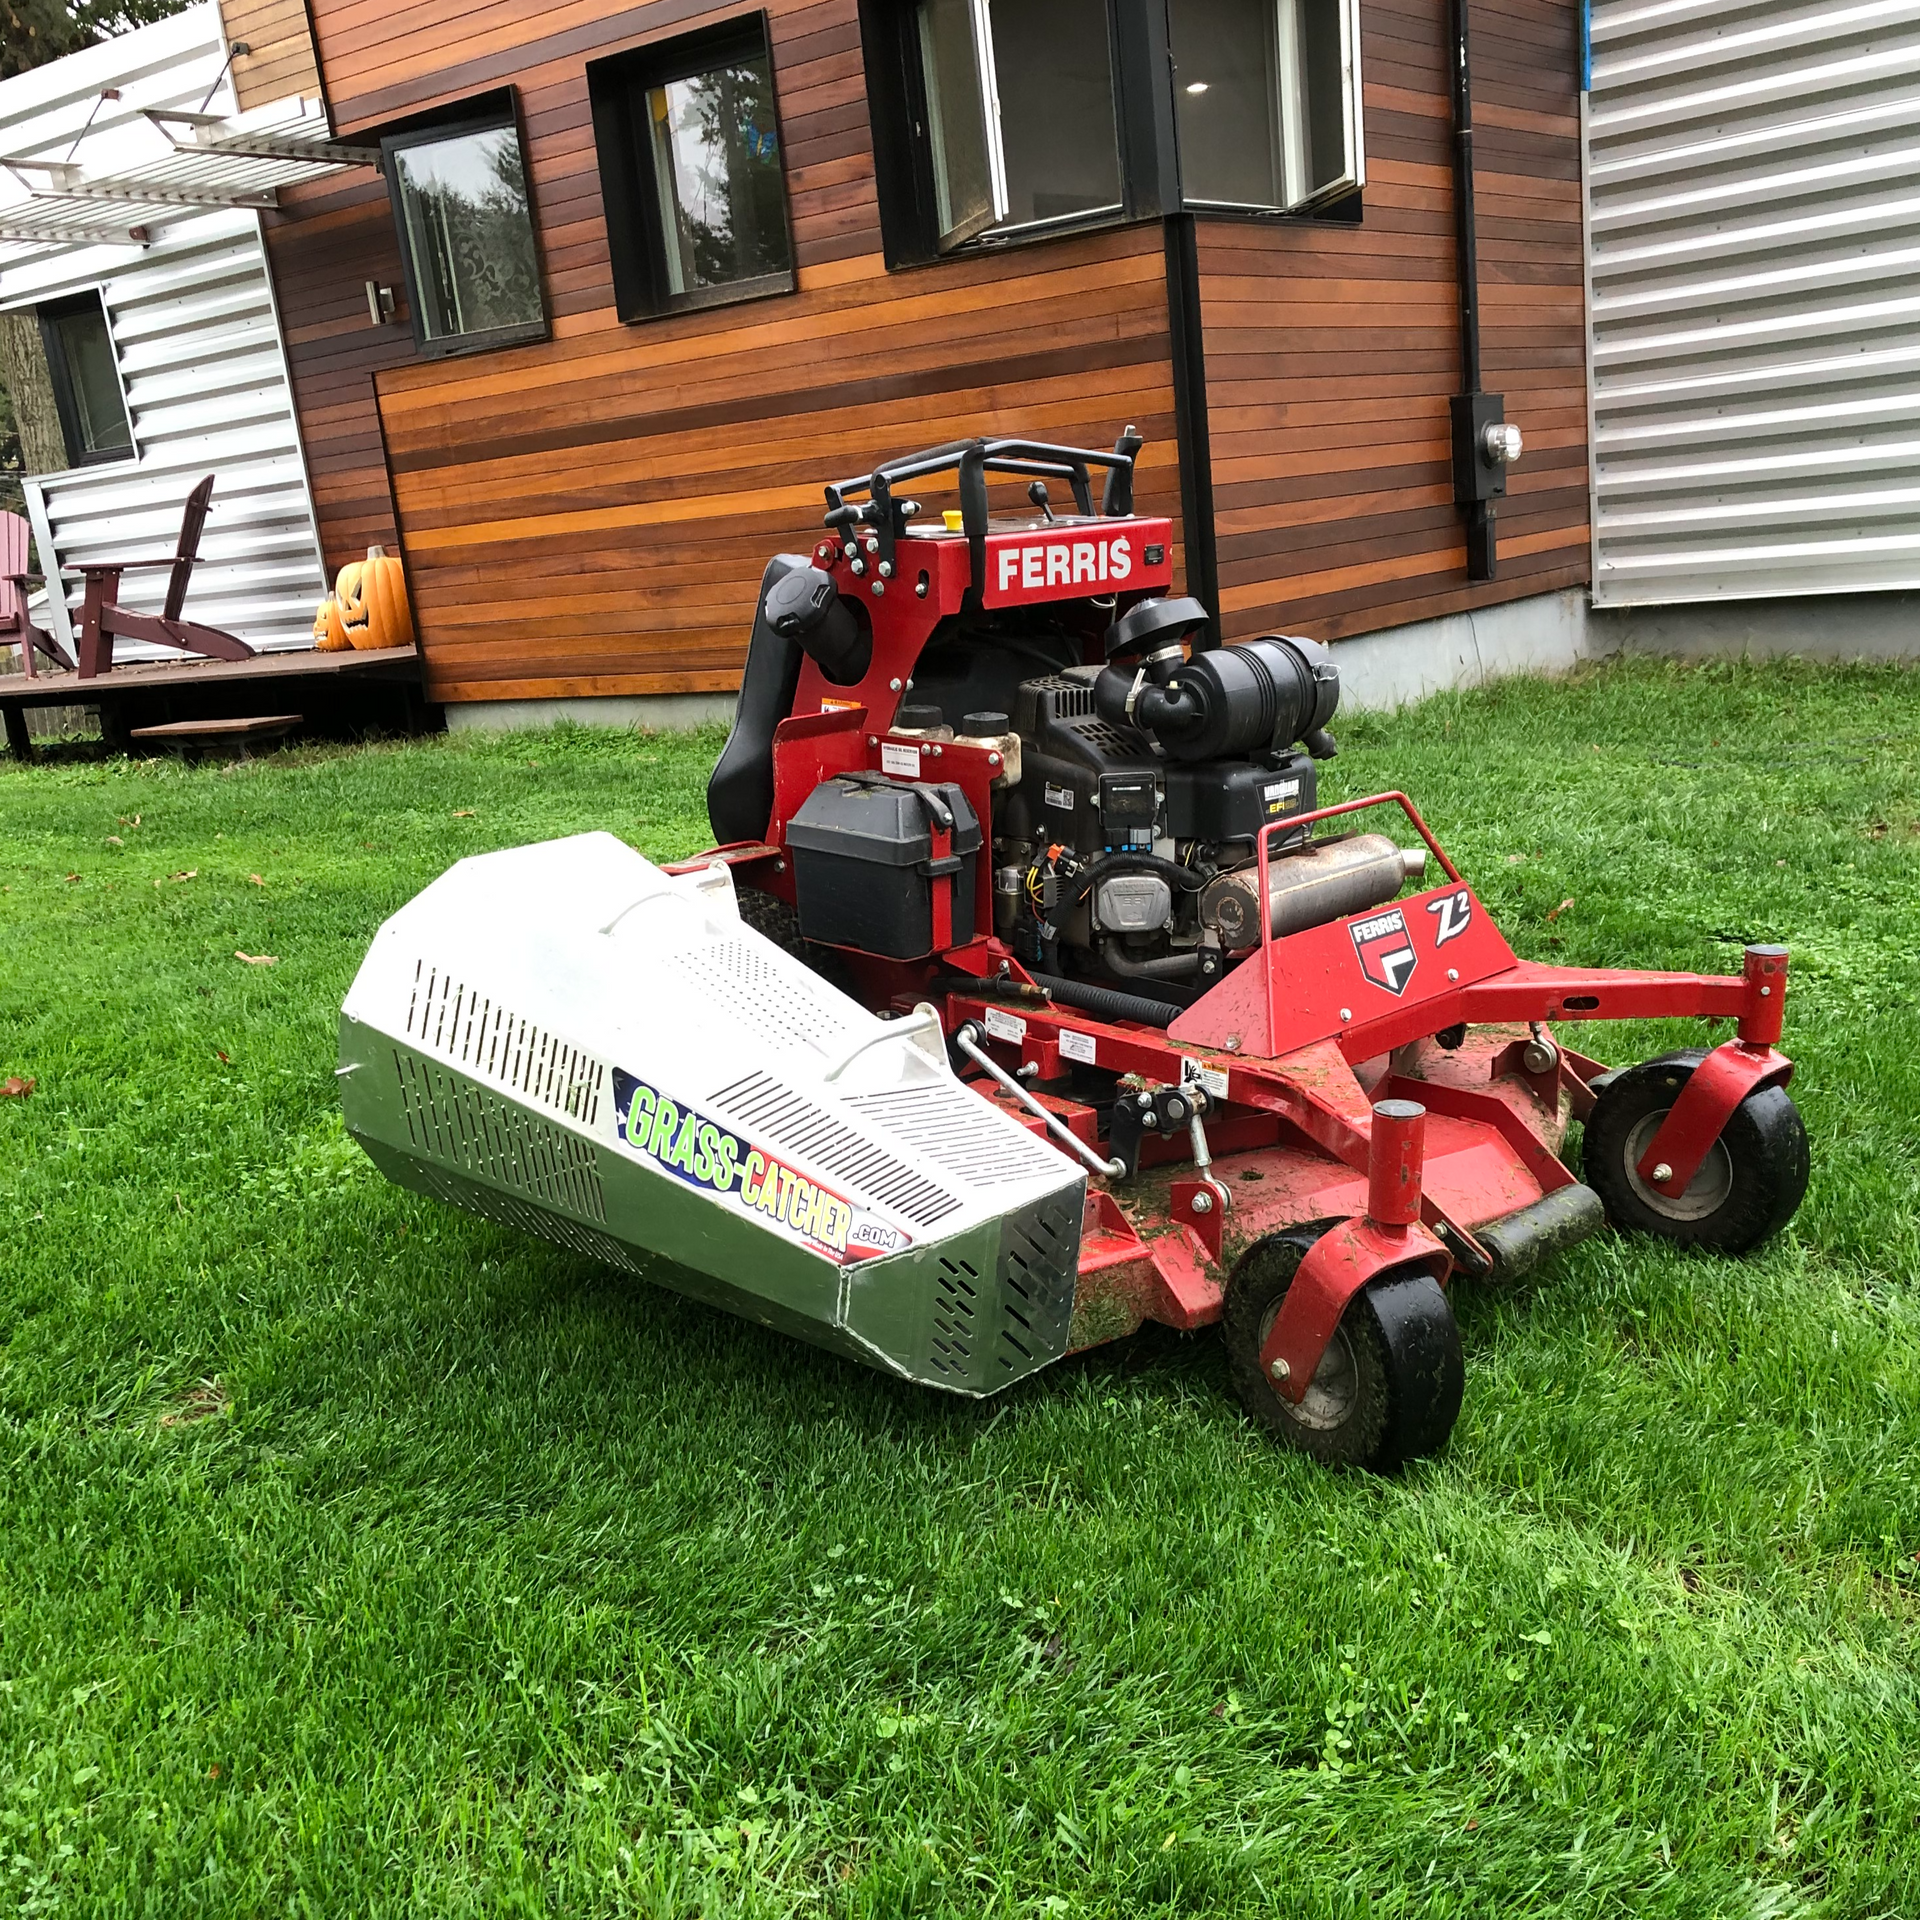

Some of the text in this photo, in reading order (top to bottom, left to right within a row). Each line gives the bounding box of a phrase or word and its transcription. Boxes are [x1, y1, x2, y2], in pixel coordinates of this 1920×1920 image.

[998, 538, 1132, 591] FERRIS
[1269, 801, 1285, 814] EFI
[1352, 912, 1403, 943] FERRIS
[624, 1085, 897, 1253] GRASS-CATCHER .COM
